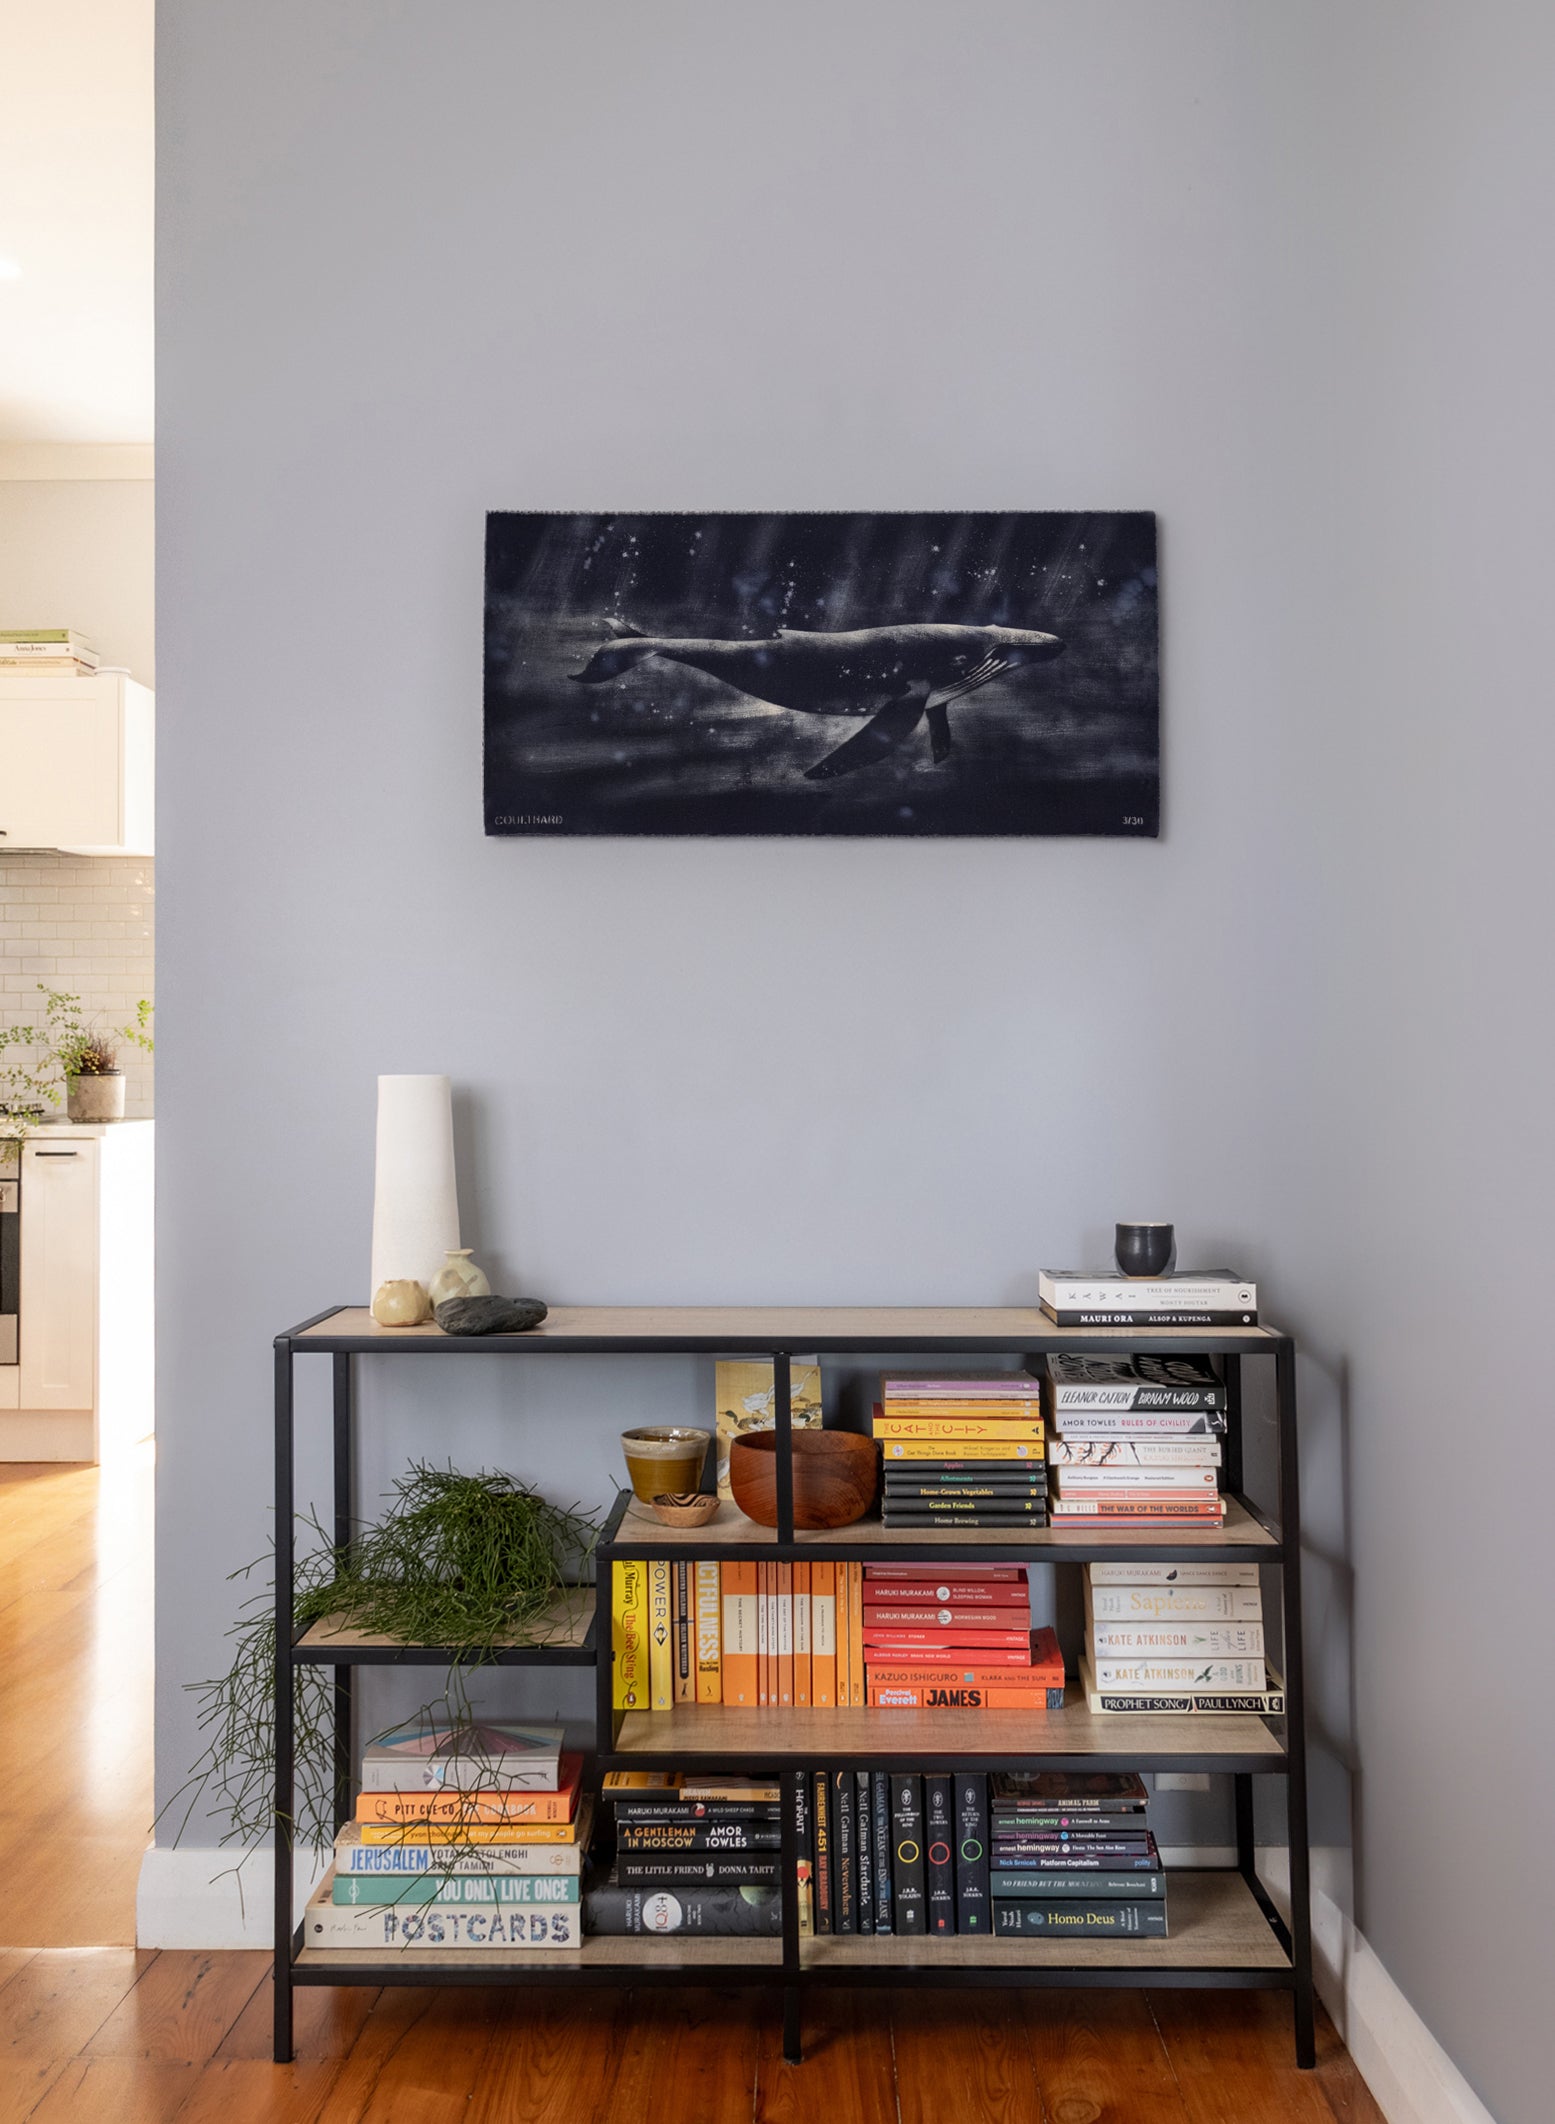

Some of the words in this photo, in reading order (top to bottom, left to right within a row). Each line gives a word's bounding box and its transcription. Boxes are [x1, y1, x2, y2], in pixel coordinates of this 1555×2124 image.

[1121, 816, 1144, 825] 3/30
[1061, 1391, 1097, 1405] ELEANOR
[1098, 1391, 1131, 1405] CATTON
[1138, 1392, 1172, 1405] BIRNAM
[1173, 1392, 1200, 1405] WOOD
[954, 1517, 979, 1525] Brewing
[623, 1571, 636, 1606] Murray
[698, 1561, 718, 1660] CTFULNESS
[1130, 1593, 1206, 1616] Sapiens
[625, 1614, 636, 1631] The
[625, 1633, 636, 1650] Bee
[1108, 1635, 1132, 1645] KATE
[1136, 1635, 1187, 1645] ATKINSON
[1237, 1631, 1246, 1651] LIFE
[624, 1654, 636, 1679] Sting
[1116, 1670, 1140, 1679] KATE
[1144, 1670, 1195, 1679] ATKINSON
[879, 1695, 917, 1705] Everett
[927, 1690, 981, 1707] JAMES
[1104, 1699, 1152, 1709] PROPHET
[1154, 1699, 1185, 1709] SONG
[1198, 1699, 1226, 1709] PAUL
[1226, 1699, 1261, 1709] LYNCH
[817, 1782, 826, 1827] FAHRENHEIT
[841, 1793, 849, 1812] Neil
[859, 1790, 867, 1810] Neil
[394, 1804, 416, 1815] PITT
[628, 1807, 652, 1815] HARUKI
[654, 1807, 689, 1815] MURAKAMI
[795, 1789, 805, 1834] HOBBIT
[1016, 1817, 1059, 1826] hemingway
[527, 1830, 551, 1838] surfing
[624, 1828, 632, 1837] A
[634, 1828, 696, 1837] GENTLEMAN
[710, 1826, 742, 1836] AMOR
[841, 1816, 850, 1854] Gaiman
[859, 1814, 868, 1852] Gaiman
[1016, 1832, 1058, 1840] hemingway
[628, 1838, 639, 1847] IN
[643, 1838, 693, 1847] MOSCOW
[705, 1837, 747, 1847] TOWLES
[818, 1829, 827, 1852] 451
[877, 1827, 886, 1851] OCEAN
[431, 1850, 458, 1860] YOTA
[468, 1850, 528, 1860] TOLENGHI
[1017, 1844, 1059, 1852] hemingway
[350, 1849, 428, 1871] JERUSALEM
[819, 1855, 827, 1870] RAY
[1040, 1859, 1065, 1867] Platform
[1067, 1859, 1099, 1867] Capitalism
[626, 1866, 642, 1874] THE
[645, 1866, 672, 1874] LITTLE
[674, 1866, 704, 1874] FRIEND
[878, 1869, 888, 1883] END
[436, 1880, 461, 1901] YOU
[465, 1880, 499, 1901] ONLY
[501, 1880, 530, 1901] LIVE
[534, 1880, 569, 1901] ONCE
[819, 1871, 828, 1910] BRADBURY
[879, 1900, 888, 1919] LANE
[1048, 1913, 1084, 1924] Homo
[1086, 1913, 1115, 1924] Deus
[384, 1913, 570, 1943] POSTCARDS
